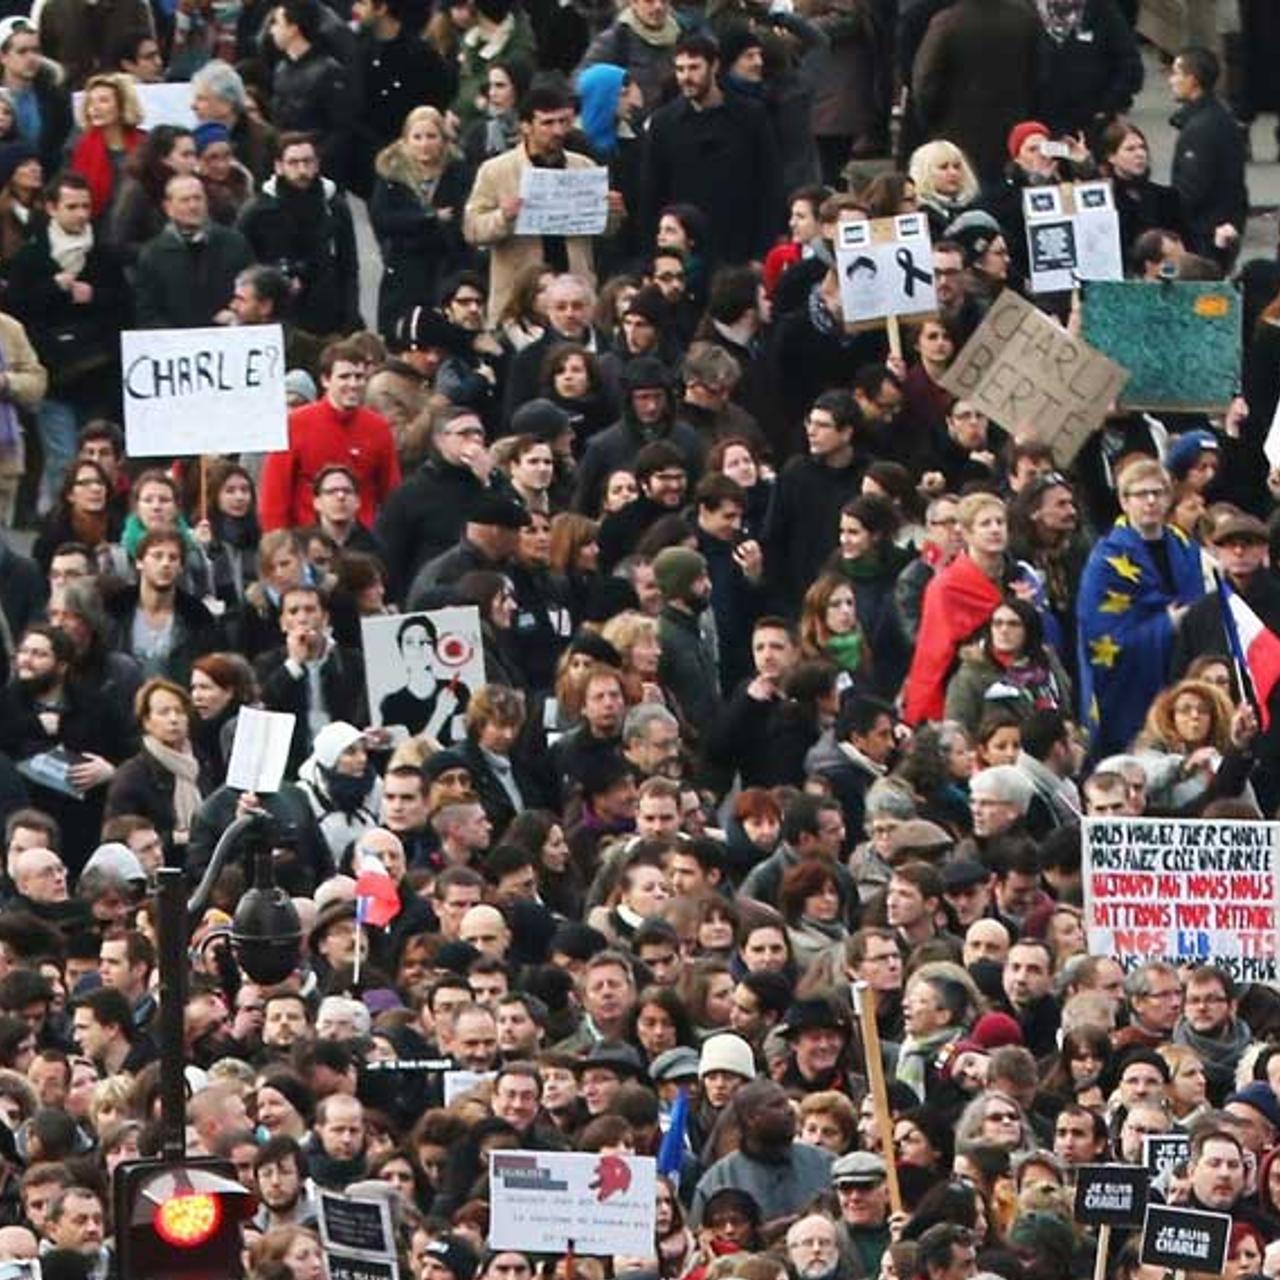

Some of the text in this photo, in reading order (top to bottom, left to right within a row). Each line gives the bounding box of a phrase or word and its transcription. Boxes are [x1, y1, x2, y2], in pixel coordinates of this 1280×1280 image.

[125, 344, 279, 400] CHARLE?
[1084, 1194, 1133, 1212] CHARLIE
[1155, 1240, 1209, 1259] CHARLIE
